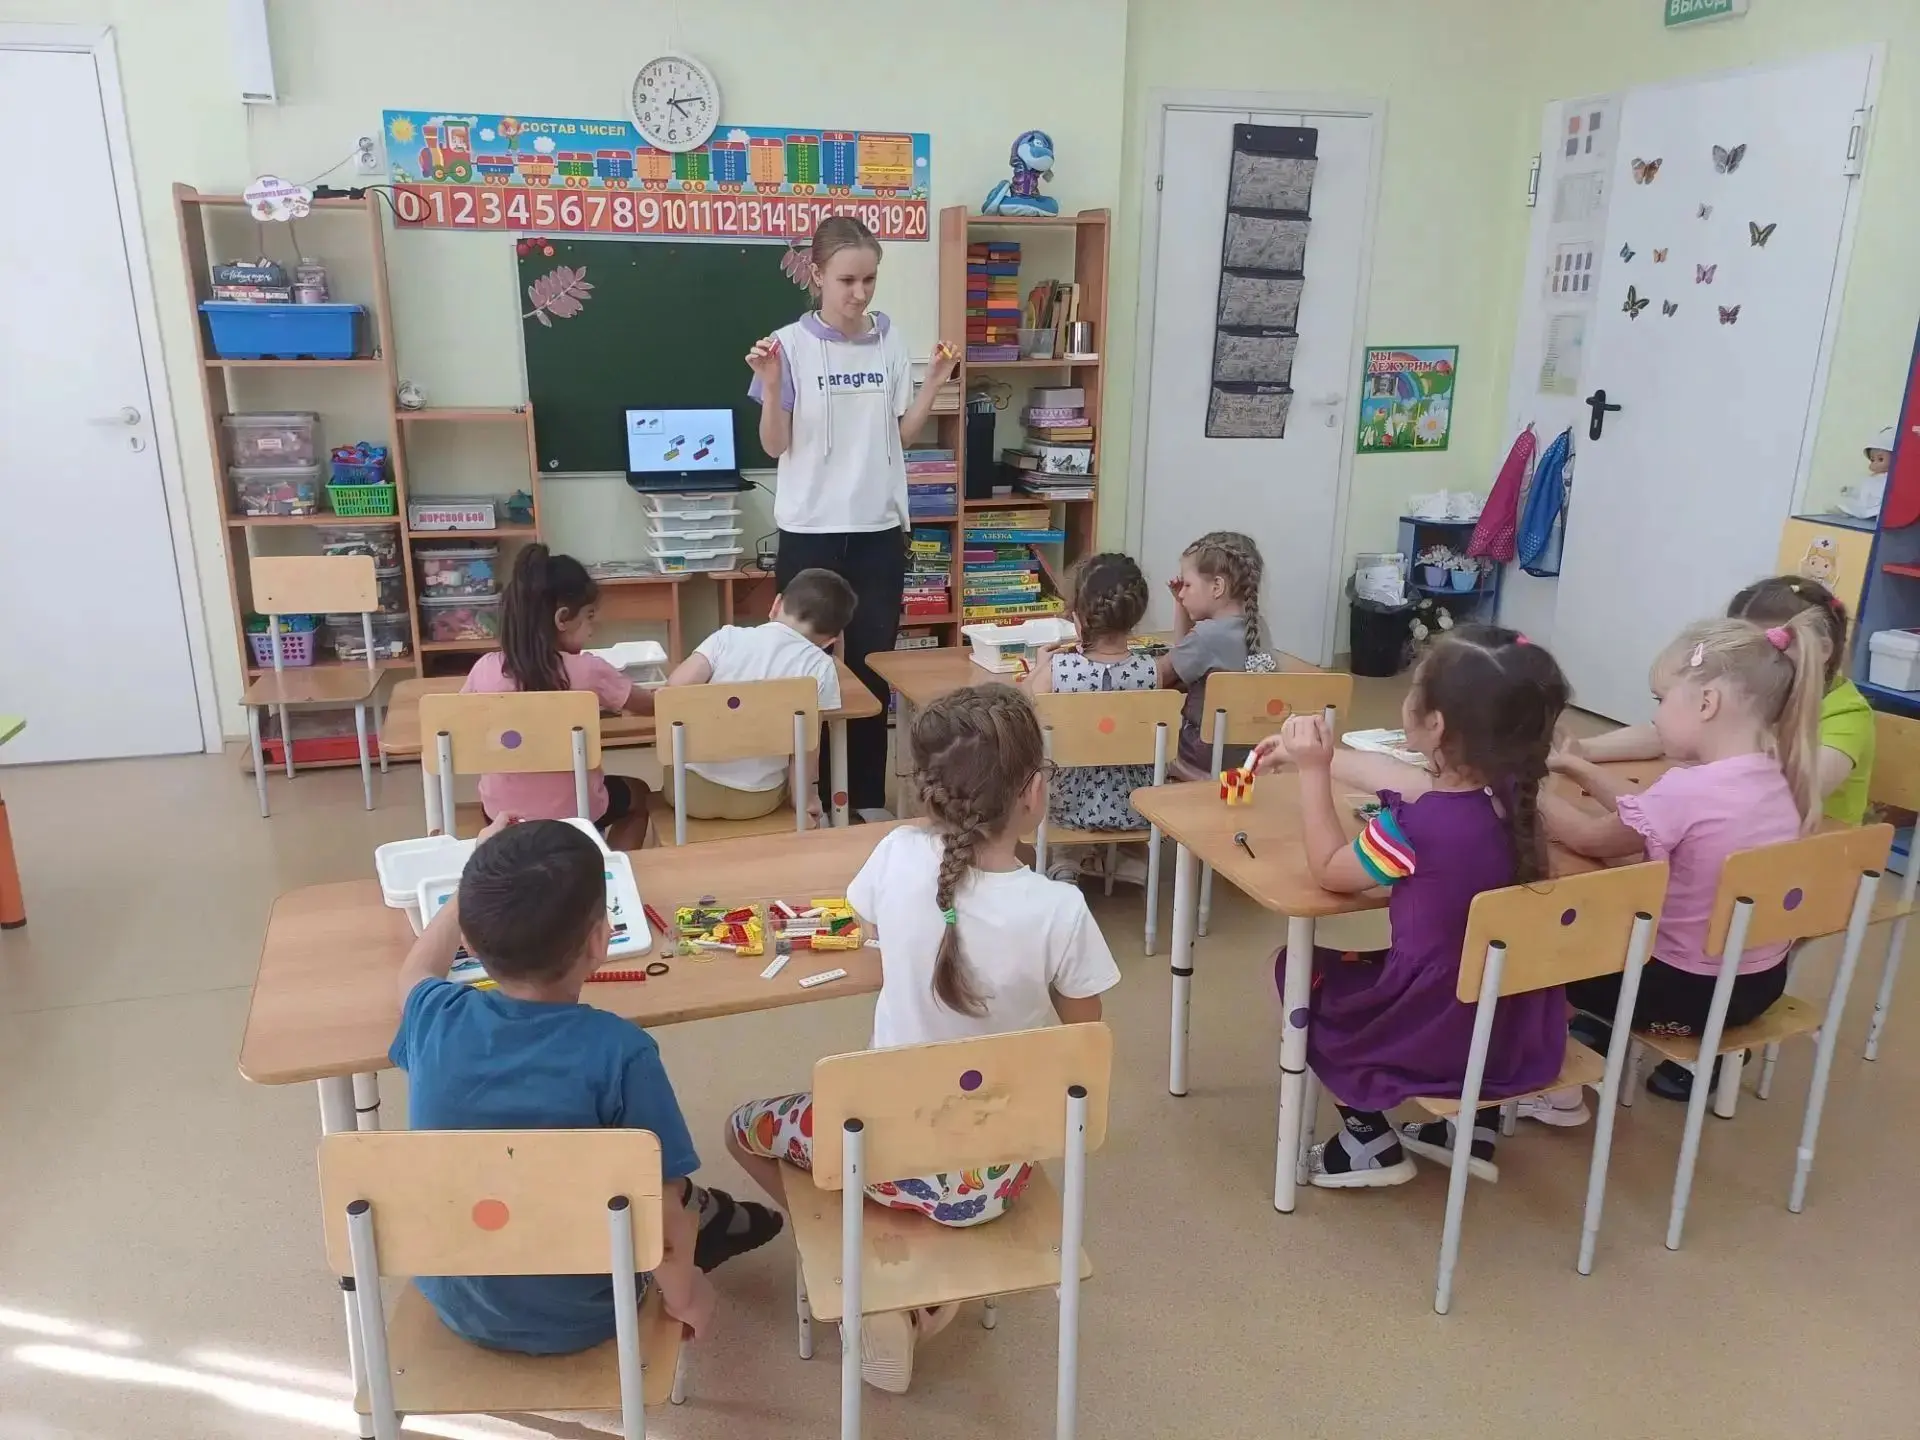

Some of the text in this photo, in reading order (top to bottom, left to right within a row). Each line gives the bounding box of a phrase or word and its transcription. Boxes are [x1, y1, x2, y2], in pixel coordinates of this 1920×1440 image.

[521, 122, 626, 136] СОСТАВ ЧИСЕЛ
[398, 191, 420, 222] 0
[429, 192, 444, 222] 1
[453, 192, 476, 224] 2
[481, 193, 501, 224] 3
[506, 195, 530, 225] 4
[536, 195, 555, 226] 5
[560, 196, 583, 227] 6
[586, 197, 607, 227] 7
[613, 197, 634, 228] 8
[639, 198, 660, 229] 9
[663, 199, 687, 229] 10
[689, 200, 711, 230] 11
[713, 201, 738, 231] 12
[738, 201, 761, 231] 13
[763, 202, 786, 232] 14
[788, 203, 810, 232] 15
[860, 205, 880, 234] 18
[882, 205, 903, 234] 19
[905, 206, 926, 235] 20
[1370, 352, 1392, 360] МЫ
[419, 512, 485, 523] МОРСКОЙ БОЙ
